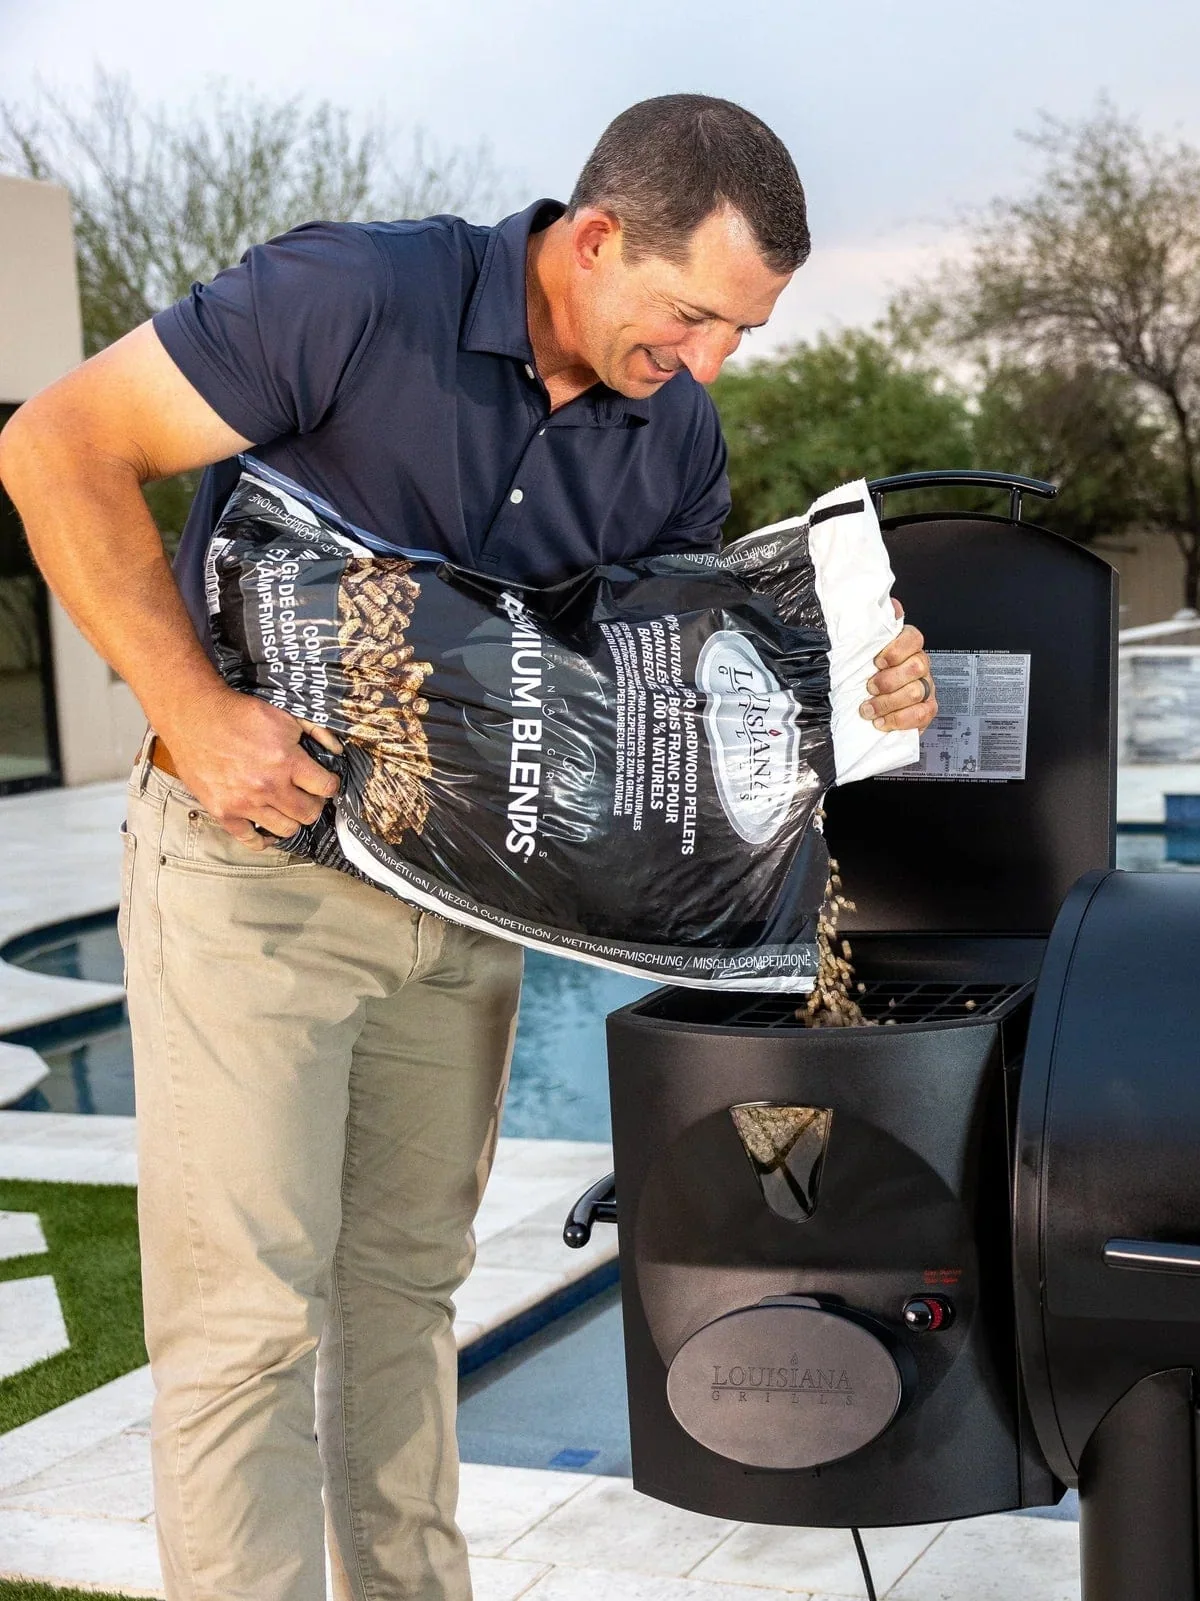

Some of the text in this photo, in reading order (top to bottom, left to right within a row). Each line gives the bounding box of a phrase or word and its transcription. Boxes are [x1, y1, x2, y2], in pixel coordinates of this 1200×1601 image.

[279, 583, 296, 608] DE
[302, 625, 329, 711] COMTITION
[496, 592, 542, 708] REMIUM
[609, 645, 624, 665] LEGNO
[625, 639, 639, 669] MADERA
[649, 622, 670, 684] GRANULÉS
[669, 633, 685, 688] NATURAL
[615, 665, 626, 688] DURO
[616, 688, 626, 705] PER
[637, 690, 647, 712] PARA
[653, 692, 667, 719] 100
[667, 697, 681, 730] BOIS
[616, 705, 626, 749] BARBECUE
[636, 713, 647, 757] BARBACOA
[652, 722, 666, 734] %
[616, 750, 625, 772] 100%
[626, 758, 636, 777] ZUM
[636, 758, 645, 773] 100
[667, 733, 681, 780] FRANC
[683, 712, 698, 793] HARDWOOD
[650, 737, 666, 810] NATURELS
[613, 774, 624, 816] NATURALE
[624, 779, 634, 815] GRILLEN
[633, 784, 644, 831] NATURALES
[665, 783, 680, 824] POUR
[681, 796, 697, 855] PELLETS
[438, 889, 478, 914] MEZCLA
[559, 936, 684, 969] WETTKAMPFMISCHUNG
[711, 1366, 853, 1390] LOUISIANA
[711, 1391, 855, 1406] GRILLS
